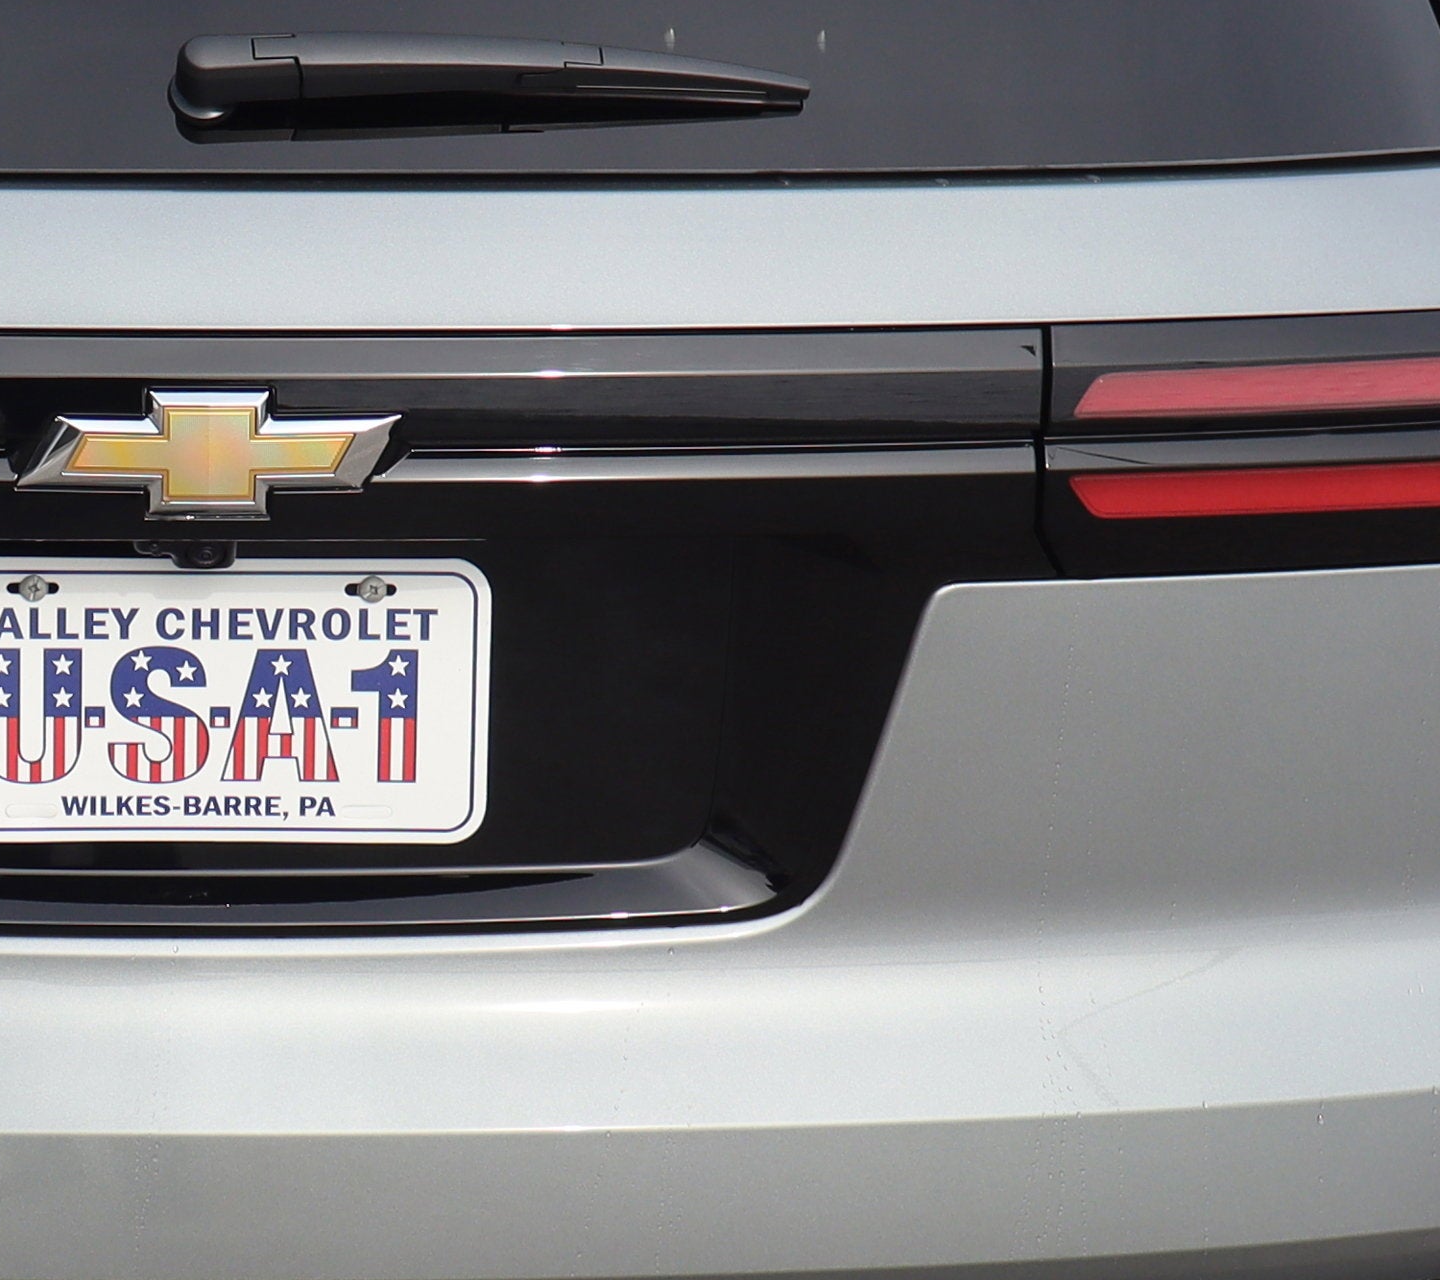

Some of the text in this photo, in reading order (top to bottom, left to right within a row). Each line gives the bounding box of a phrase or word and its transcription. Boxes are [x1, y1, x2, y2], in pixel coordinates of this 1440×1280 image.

[154, 606, 439, 642] CHEVROLET
[61, 795, 336, 821] WILKES-BARRE, PA
